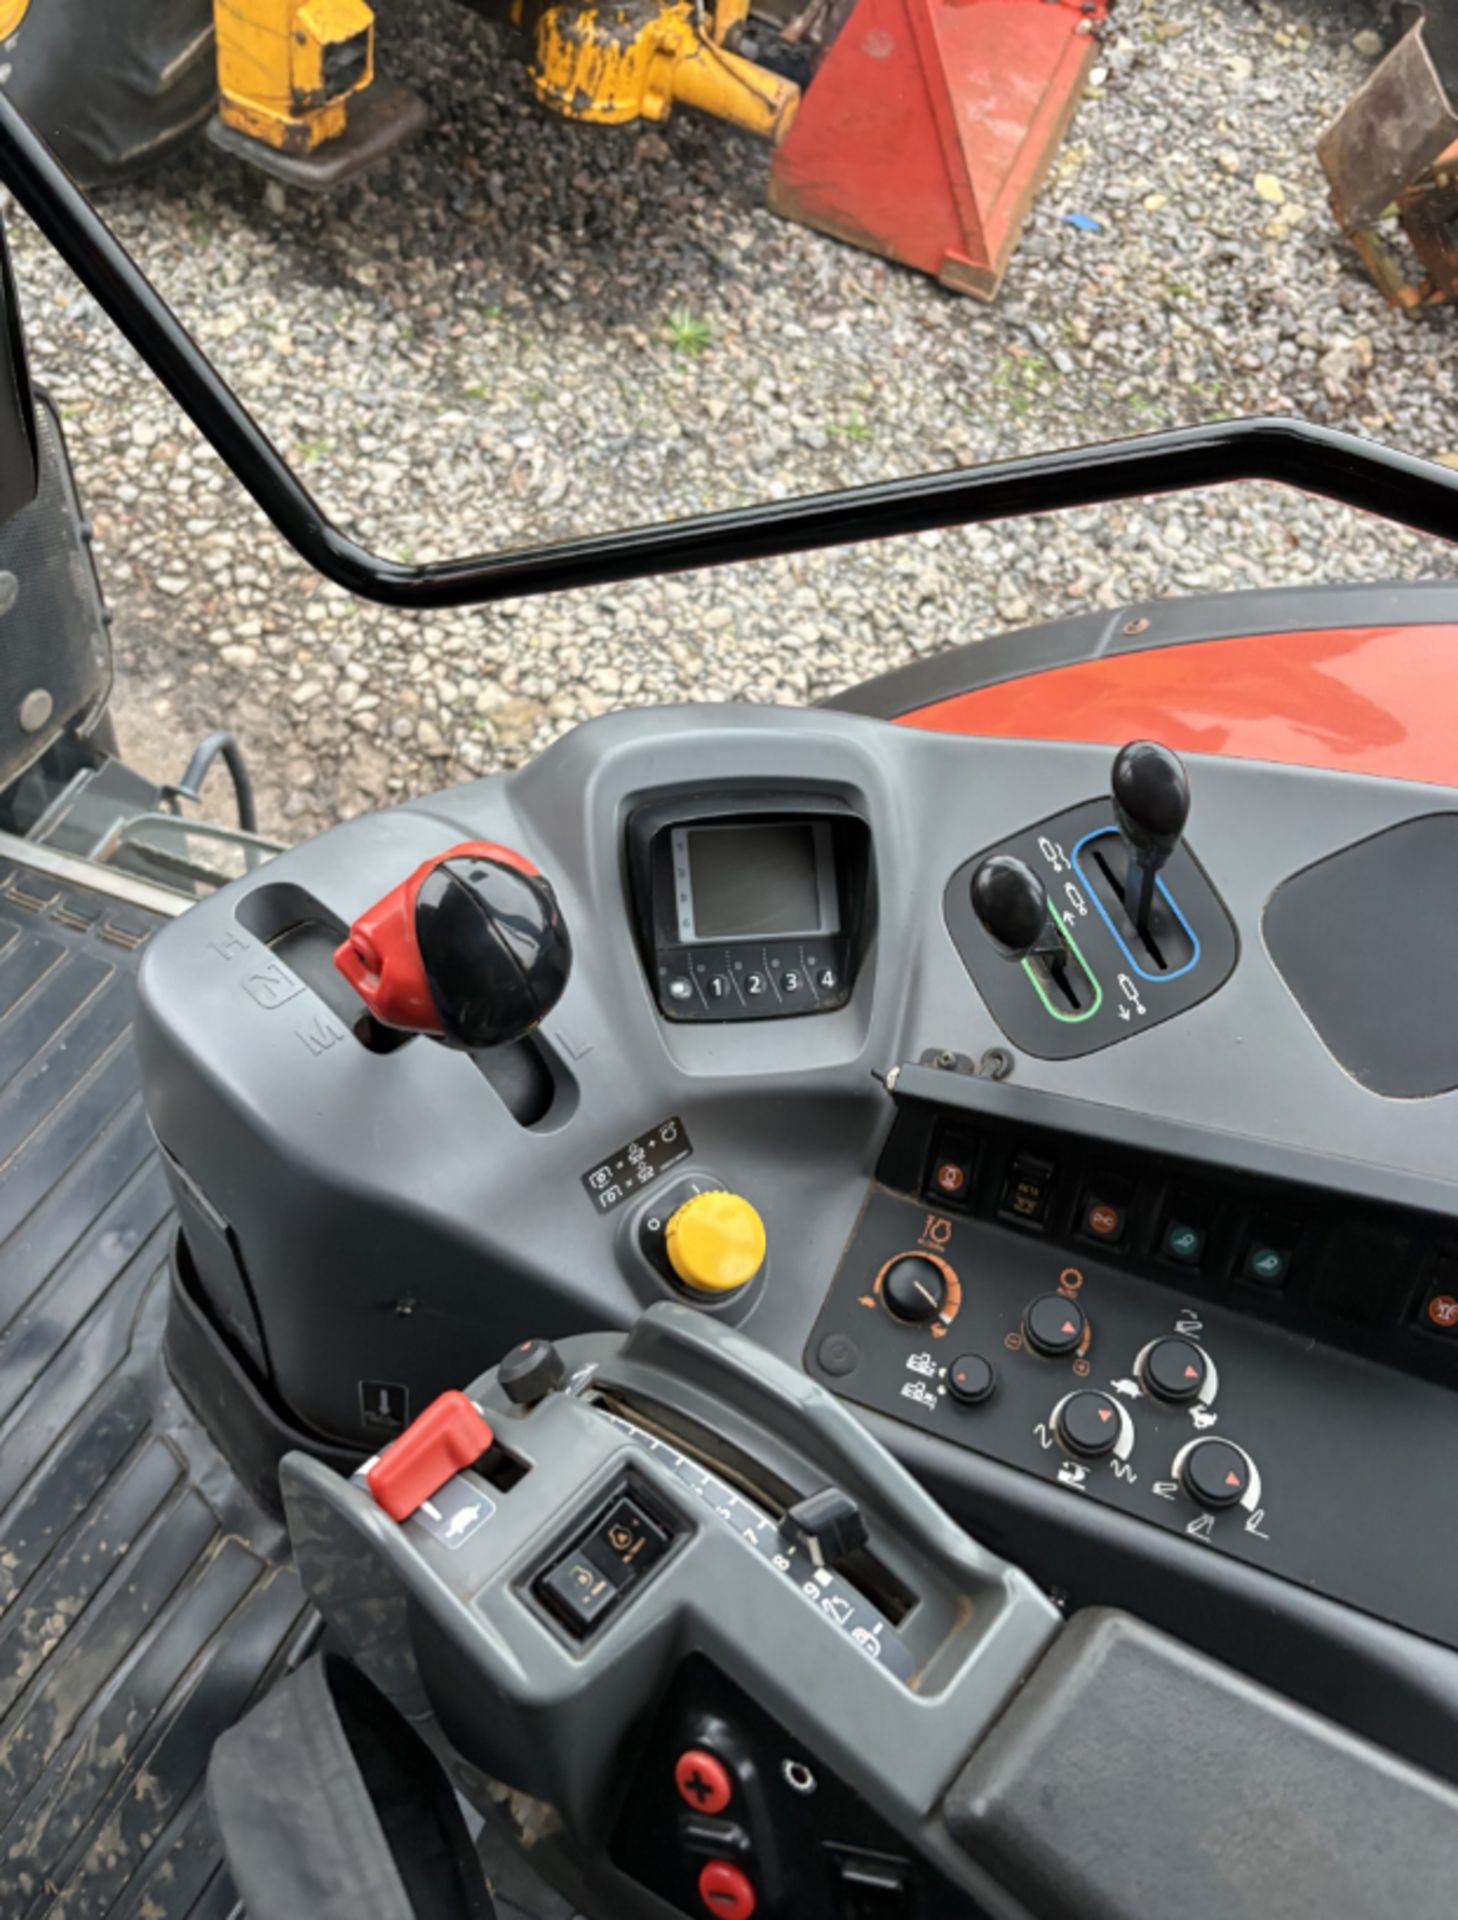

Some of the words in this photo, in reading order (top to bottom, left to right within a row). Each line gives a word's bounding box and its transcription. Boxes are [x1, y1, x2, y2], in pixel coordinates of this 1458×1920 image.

[712, 977, 722, 997] 1
[749, 975, 763, 995] 2
[785, 972, 799, 992] 3
[820, 970, 836, 989] 4
[771, 1553, 791, 1572] 8
[802, 1581, 821, 1600] 9
